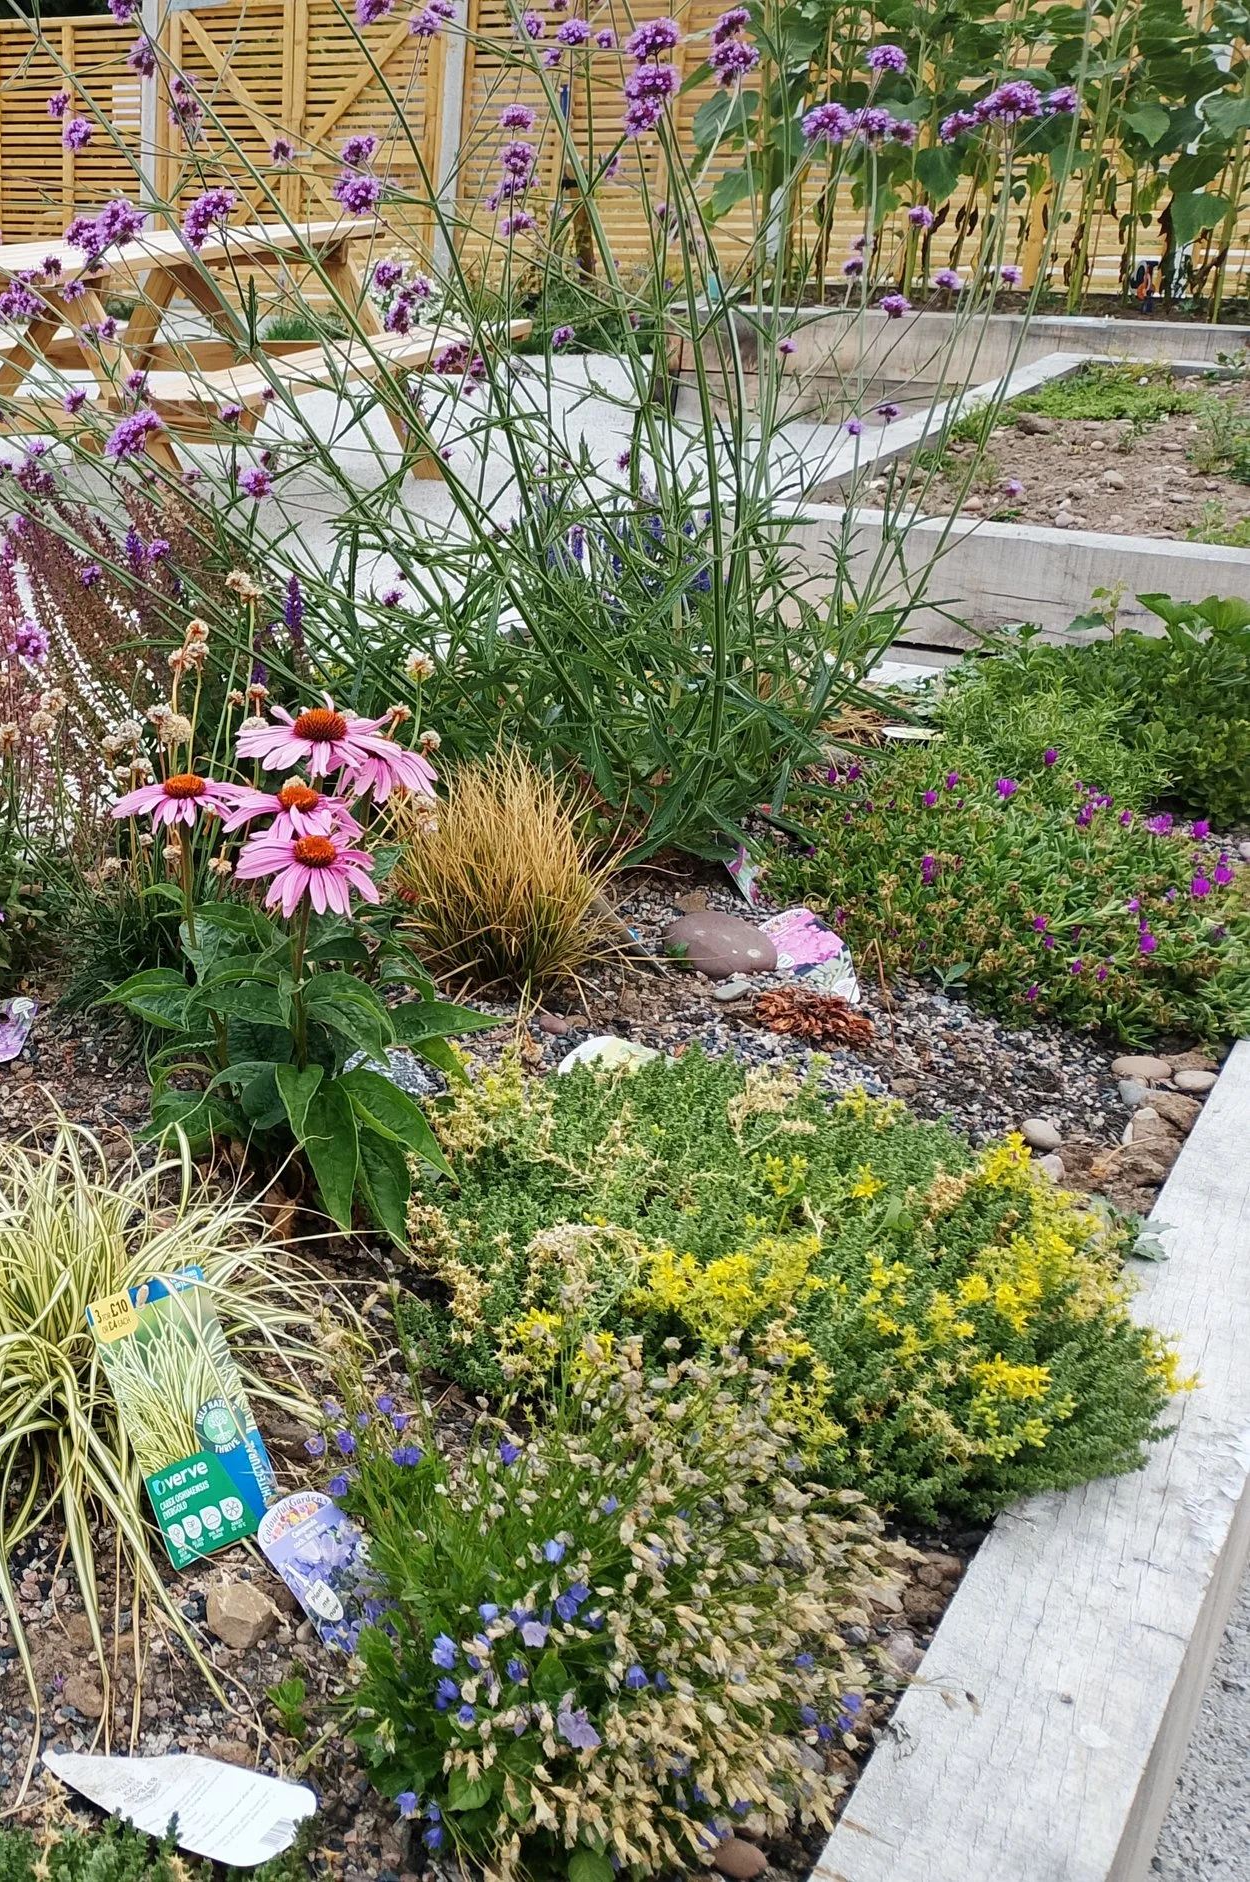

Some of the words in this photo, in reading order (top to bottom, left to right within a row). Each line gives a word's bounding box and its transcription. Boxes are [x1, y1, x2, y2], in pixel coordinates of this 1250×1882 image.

[95, 1309, 102, 1323] 3
[110, 1298, 129, 1319] £10
[108, 1320, 118, 1332] £4
[117, 1316, 131, 1328] EACH
[195, 1406, 208, 1425] HELP
[207, 1399, 237, 1411] NATU
[215, 1438, 240, 1453] THRIVE
[165, 1462, 208, 1489] verve
[264, 1502, 291, 1544] Colourful
[290, 1495, 329, 1507] Gardens
[311, 1584, 325, 1602] Plant
[329, 1603, 341, 1617] now
